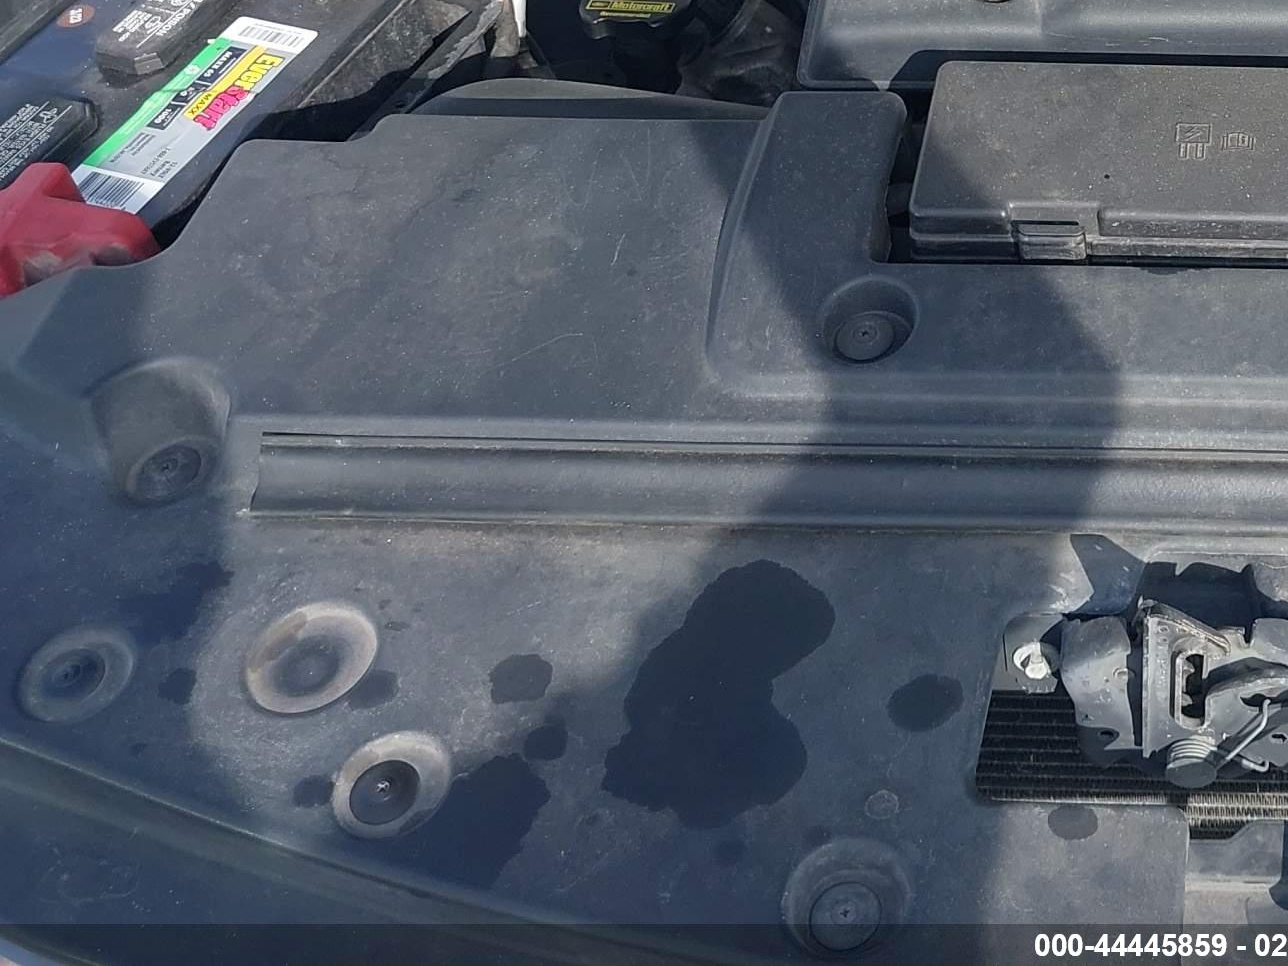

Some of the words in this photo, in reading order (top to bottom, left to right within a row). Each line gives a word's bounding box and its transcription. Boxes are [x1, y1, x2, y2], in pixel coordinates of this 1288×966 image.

[611, 1, 671, 12] Motorcraft
[155, 8, 191, 37] POISON
[211, 51, 233, 69] MAXX
[193, 52, 285, 131] EverStart
[188, 93, 212, 115] MAXX
